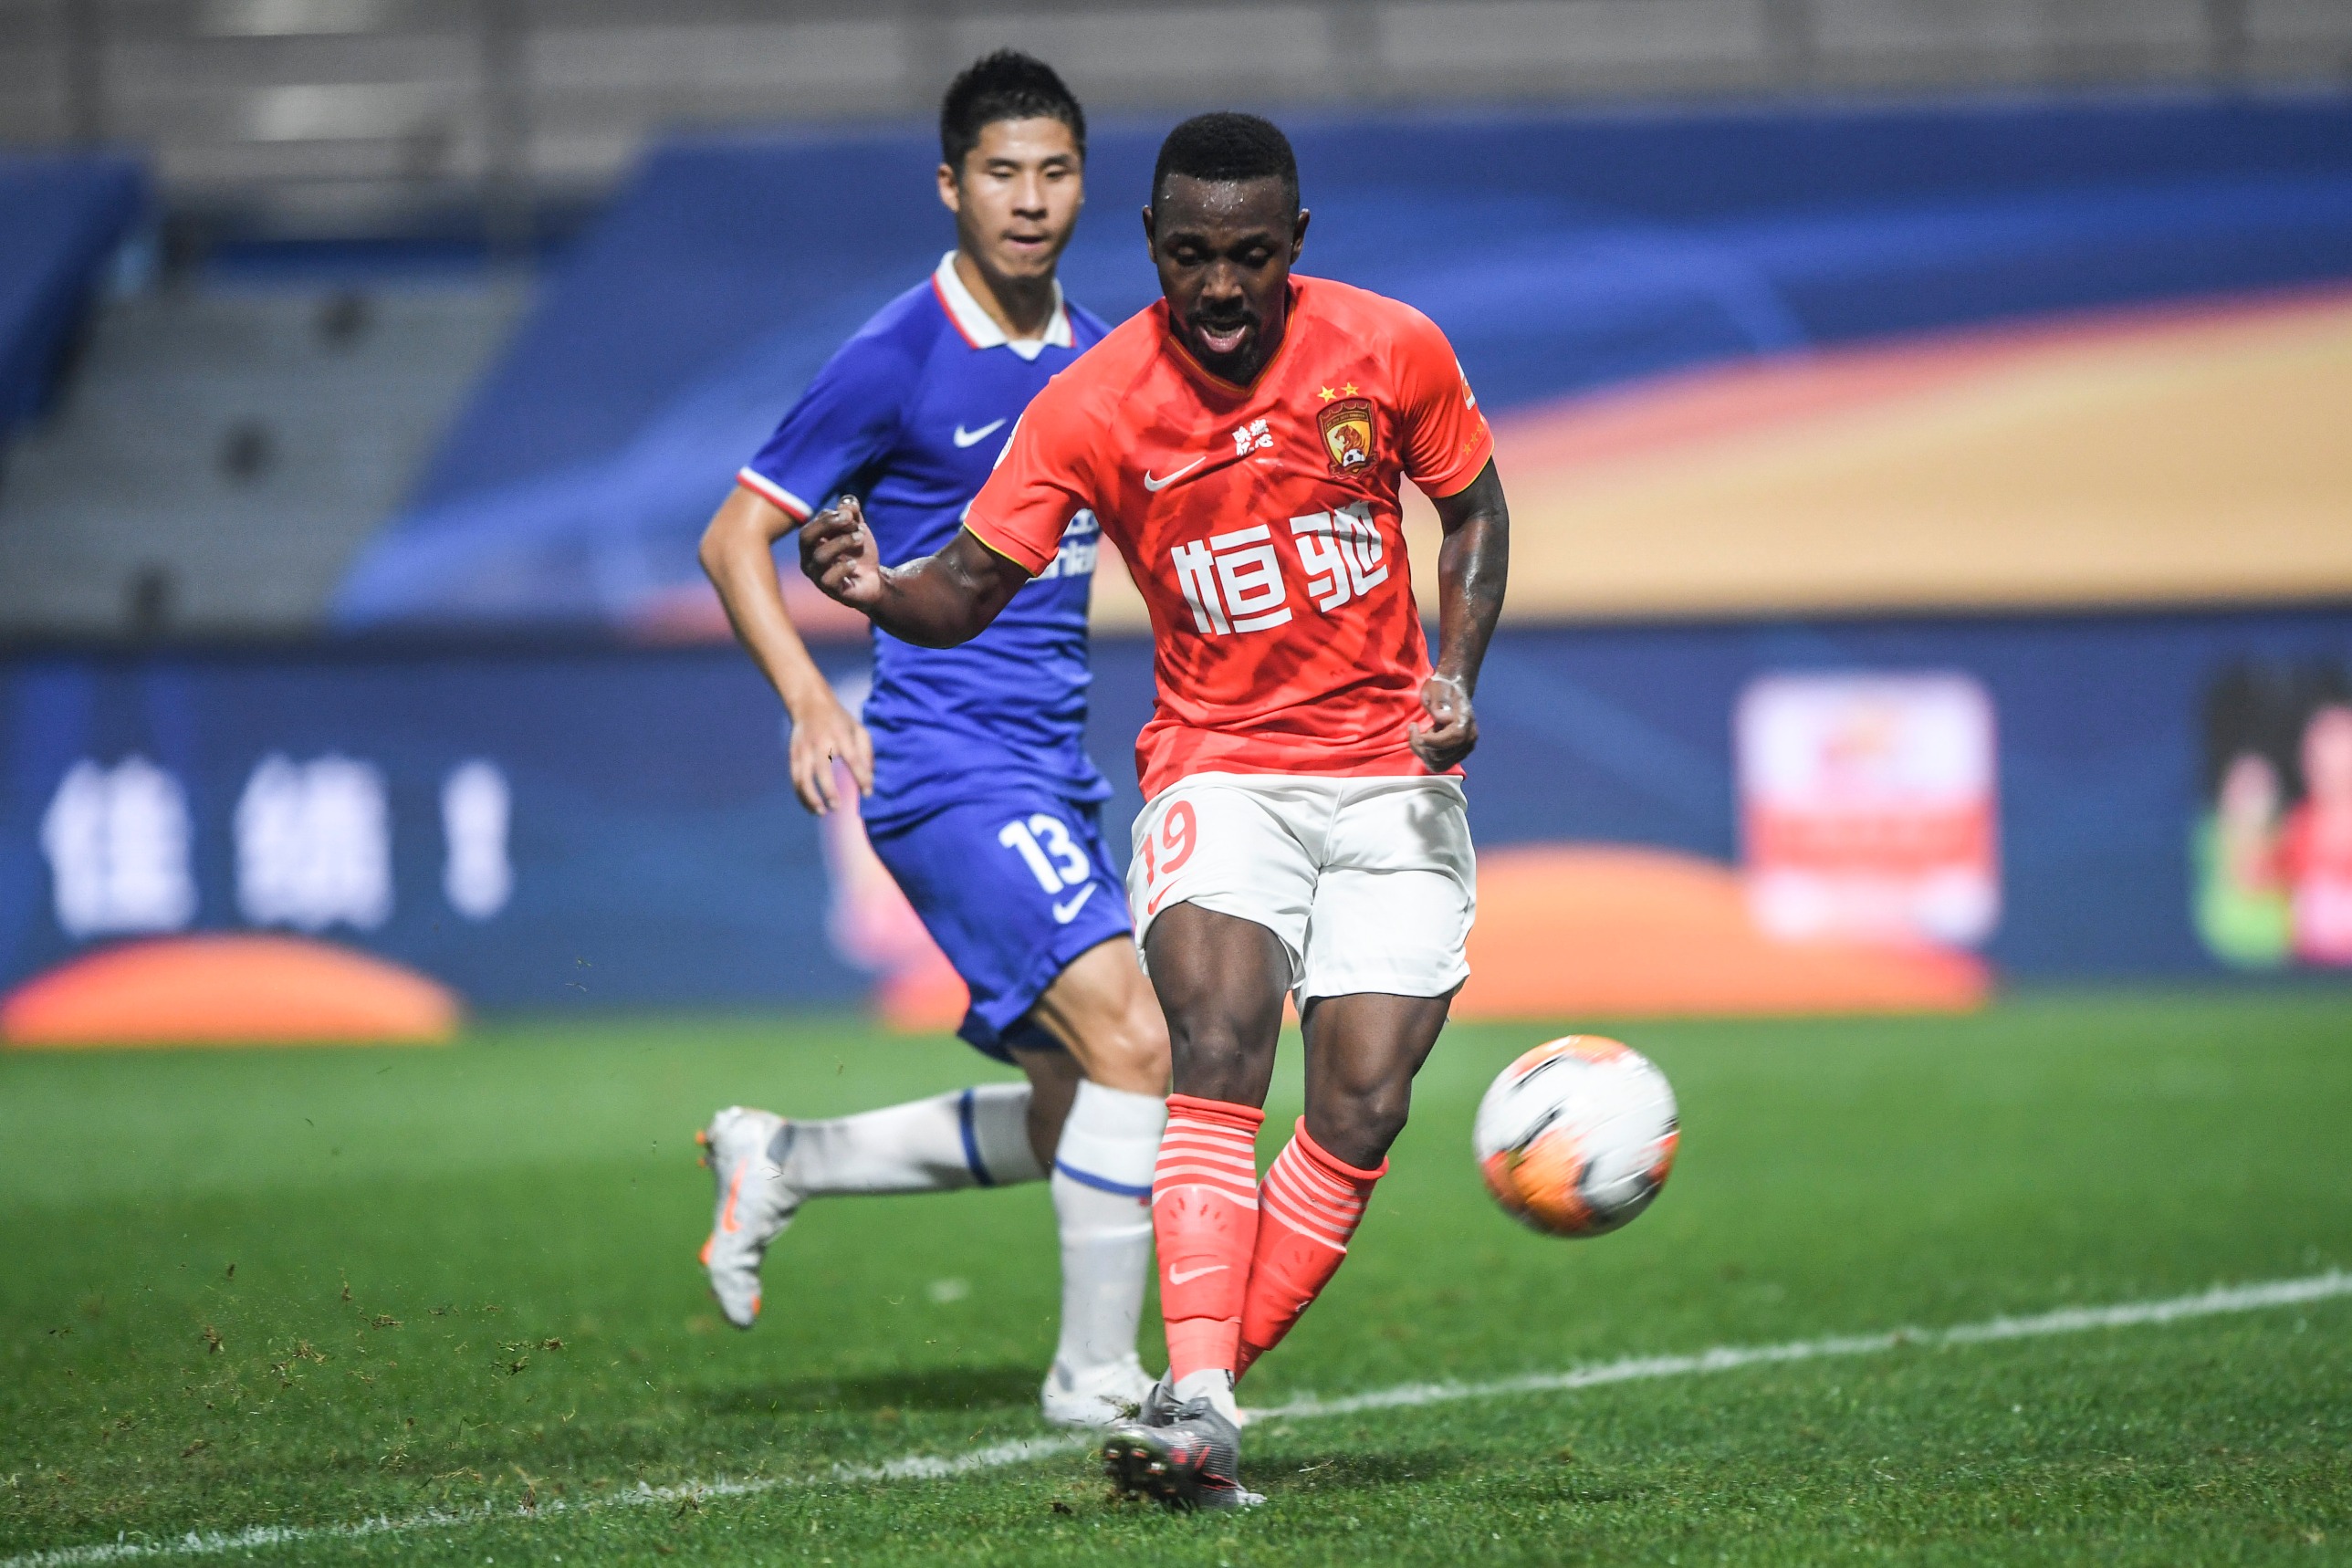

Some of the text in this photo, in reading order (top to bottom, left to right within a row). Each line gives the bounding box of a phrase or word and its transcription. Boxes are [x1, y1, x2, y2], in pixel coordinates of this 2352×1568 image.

[1171, 500, 1389, 635] 恒驰
[998, 813, 1090, 894] 13
[1140, 800, 1197, 887] 19
